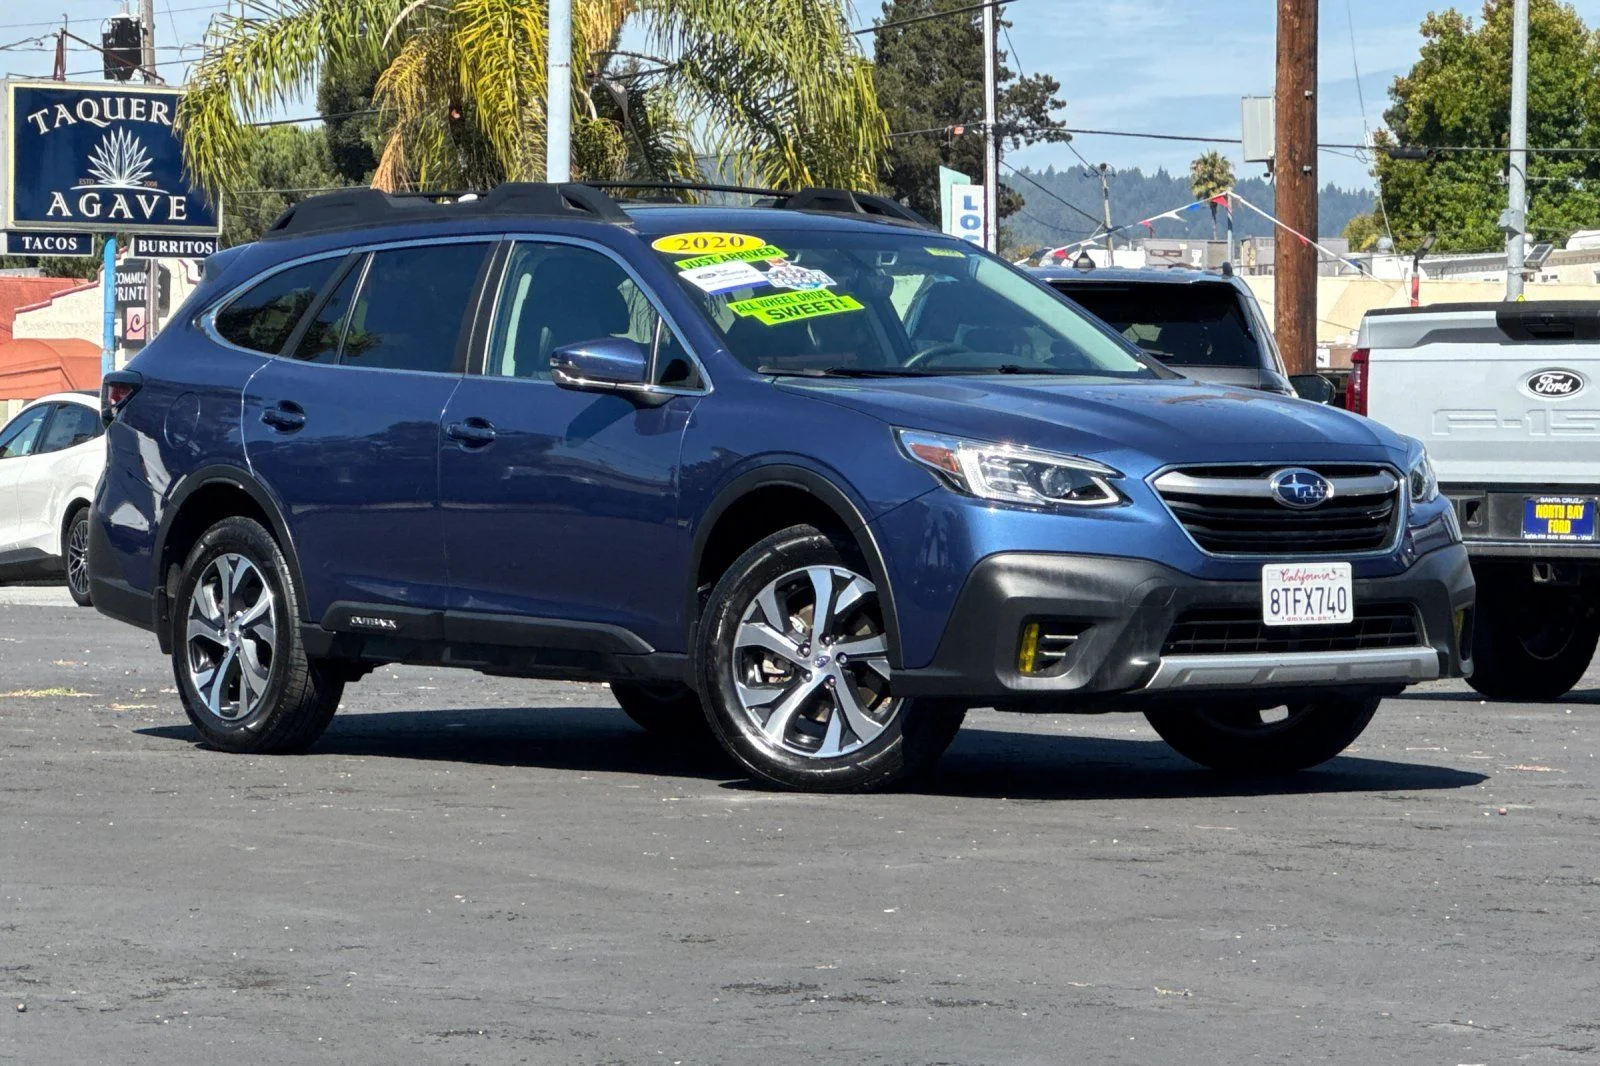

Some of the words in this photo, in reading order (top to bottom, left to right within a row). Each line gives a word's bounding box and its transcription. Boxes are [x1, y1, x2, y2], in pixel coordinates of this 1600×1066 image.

[28, 97, 174, 135] TAQUER
[46, 191, 188, 221] AGAVE
[22, 236, 77, 250] TACOS
[138, 240, 213, 254] BURRITOS
[675, 236, 744, 250] 2020
[685, 256, 718, 269] JUST
[721, 247, 776, 263] ARRIVED
[735, 302, 759, 313] ALL
[757, 295, 797, 308] WHEEL
[797, 290, 831, 302] DRIVE
[766, 299, 849, 320] SWEET!
[1535, 373, 1572, 393] Ford
[1535, 505, 1565, 519] NORTH
[1567, 505, 1584, 520] BAY
[1548, 520, 1571, 534] FORD
[1281, 568, 1336, 585] California
[1270, 587, 1347, 615] 8TFX740
